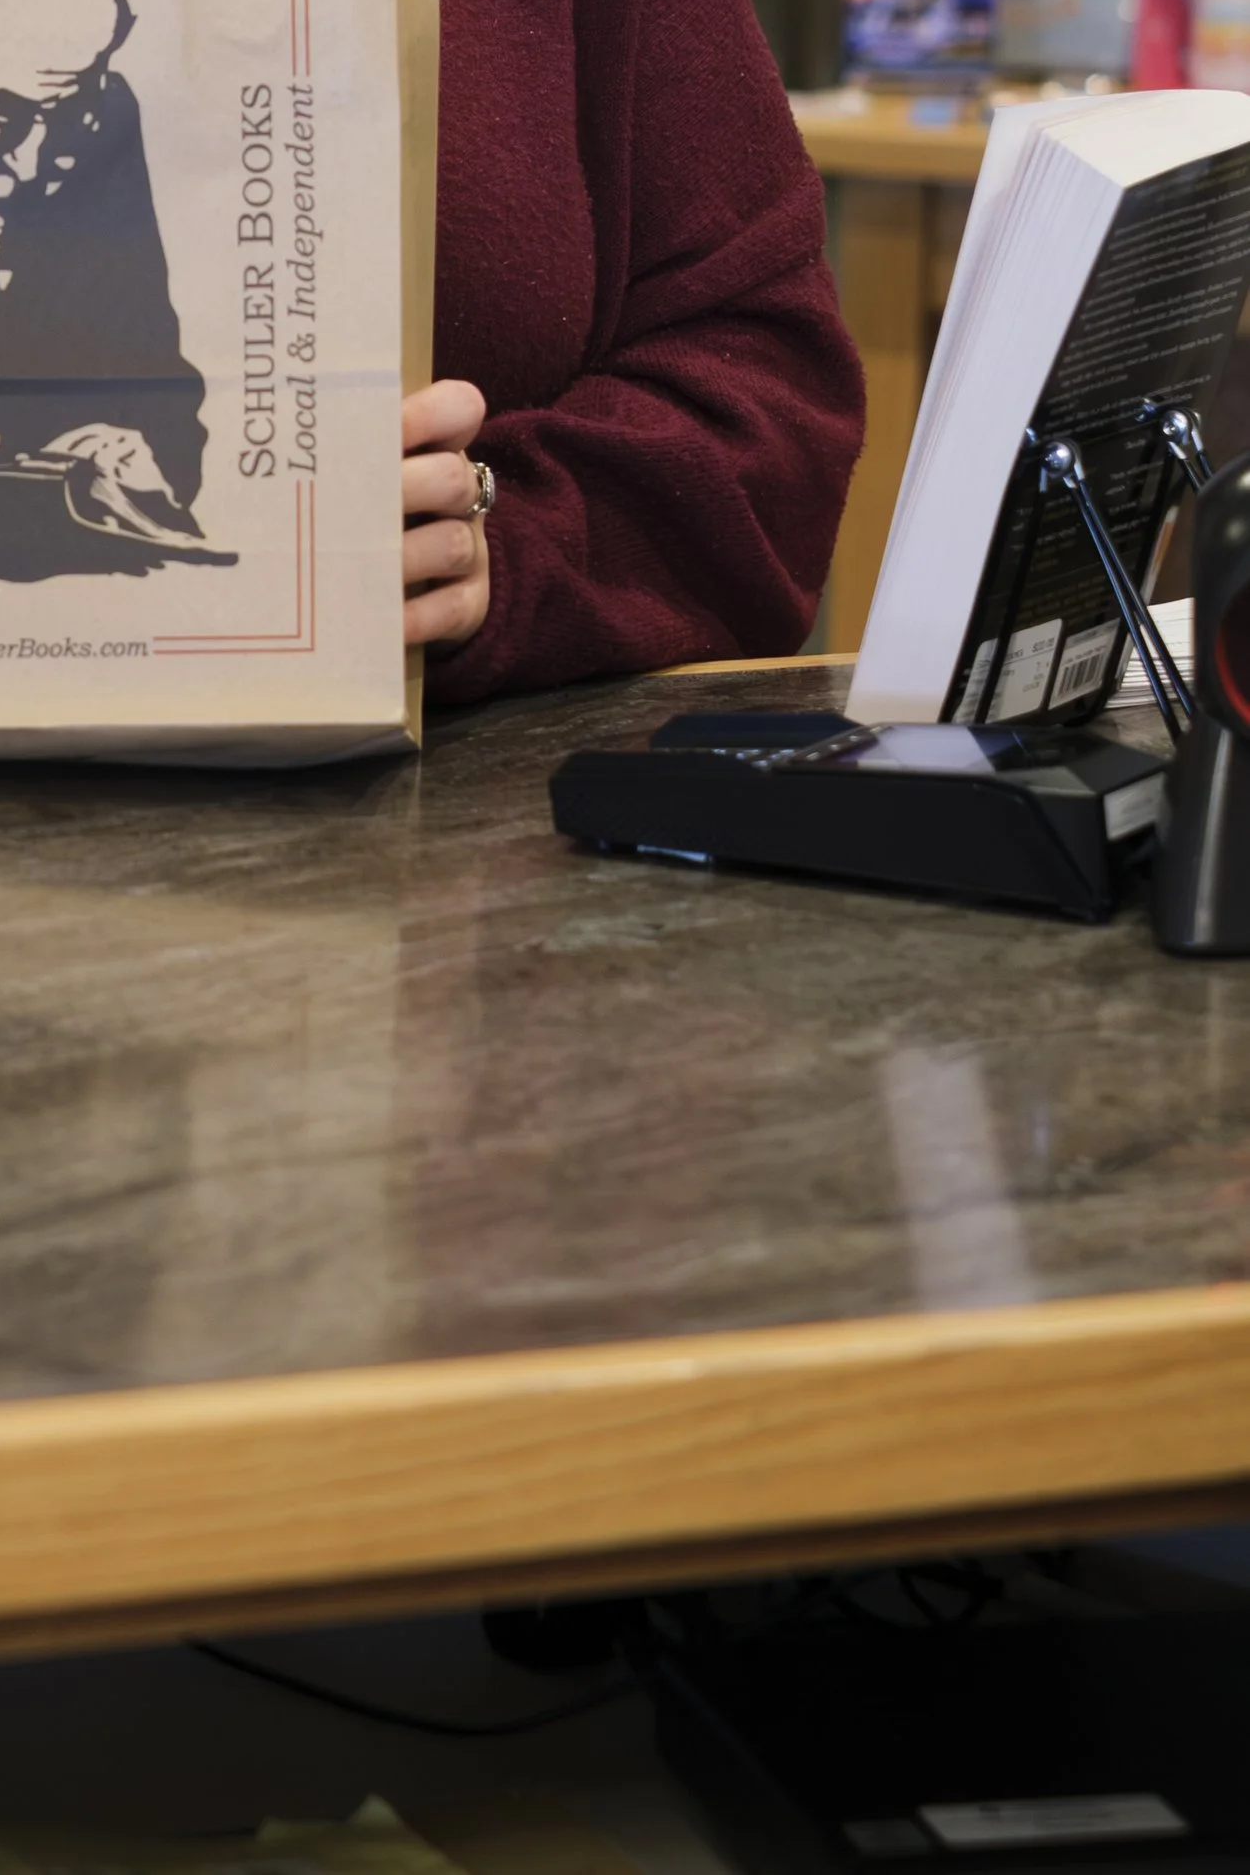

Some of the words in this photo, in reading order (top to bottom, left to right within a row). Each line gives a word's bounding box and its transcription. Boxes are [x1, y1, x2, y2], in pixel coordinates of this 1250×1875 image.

[237, 83, 274, 245] BOOKS
[284, 84, 324, 321] Independent
[238, 263, 276, 478] SCHULER
[286, 333, 317, 363] &
[286, 376, 317, 475] Local
